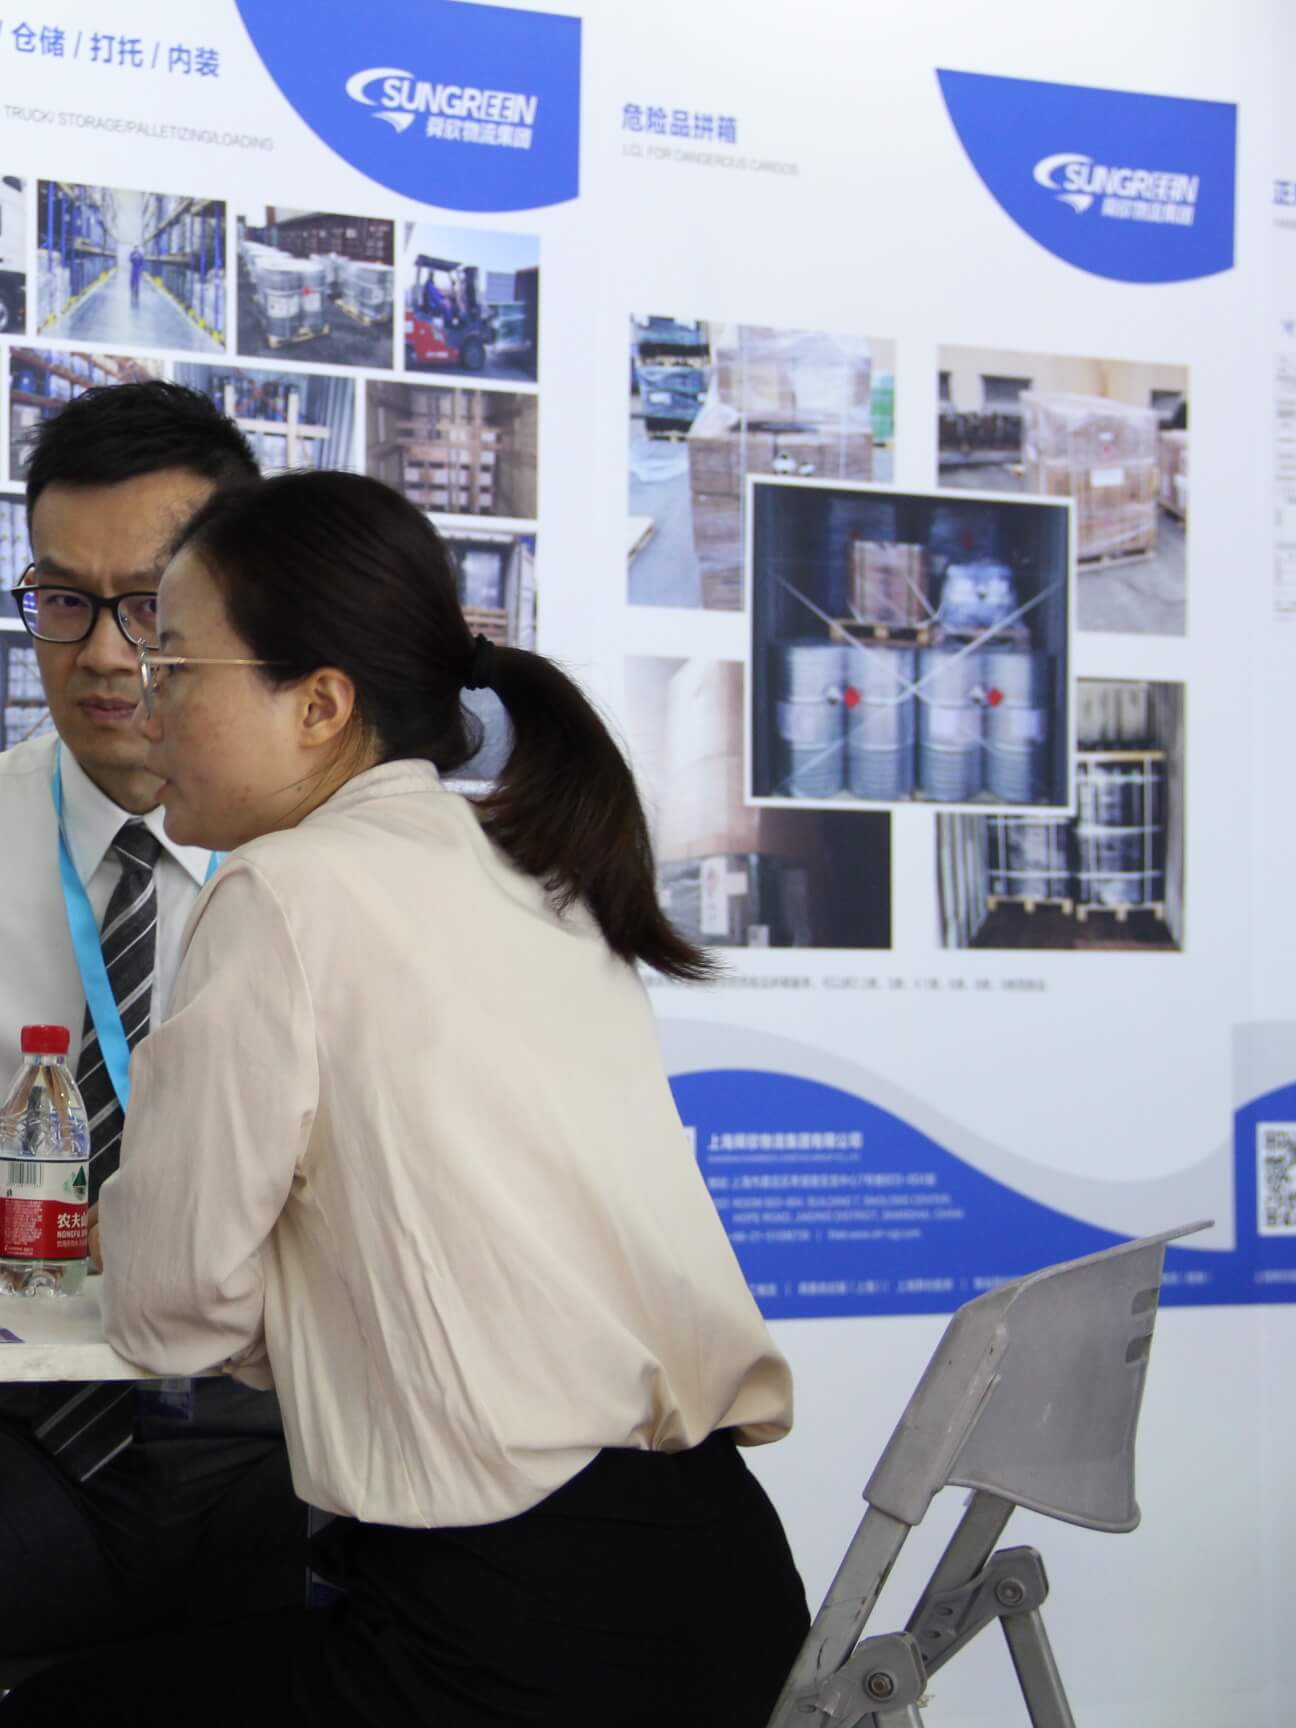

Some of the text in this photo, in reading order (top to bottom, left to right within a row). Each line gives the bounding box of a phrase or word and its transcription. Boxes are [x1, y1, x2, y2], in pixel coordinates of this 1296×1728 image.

[12, 22, 65, 58] 仓储
[90, 32, 144, 68] 打托
[168, 44, 220, 77] 内装
[381, 78, 538, 125] SUNGREEN
[1063, 163, 1200, 205] SUNGREEN
